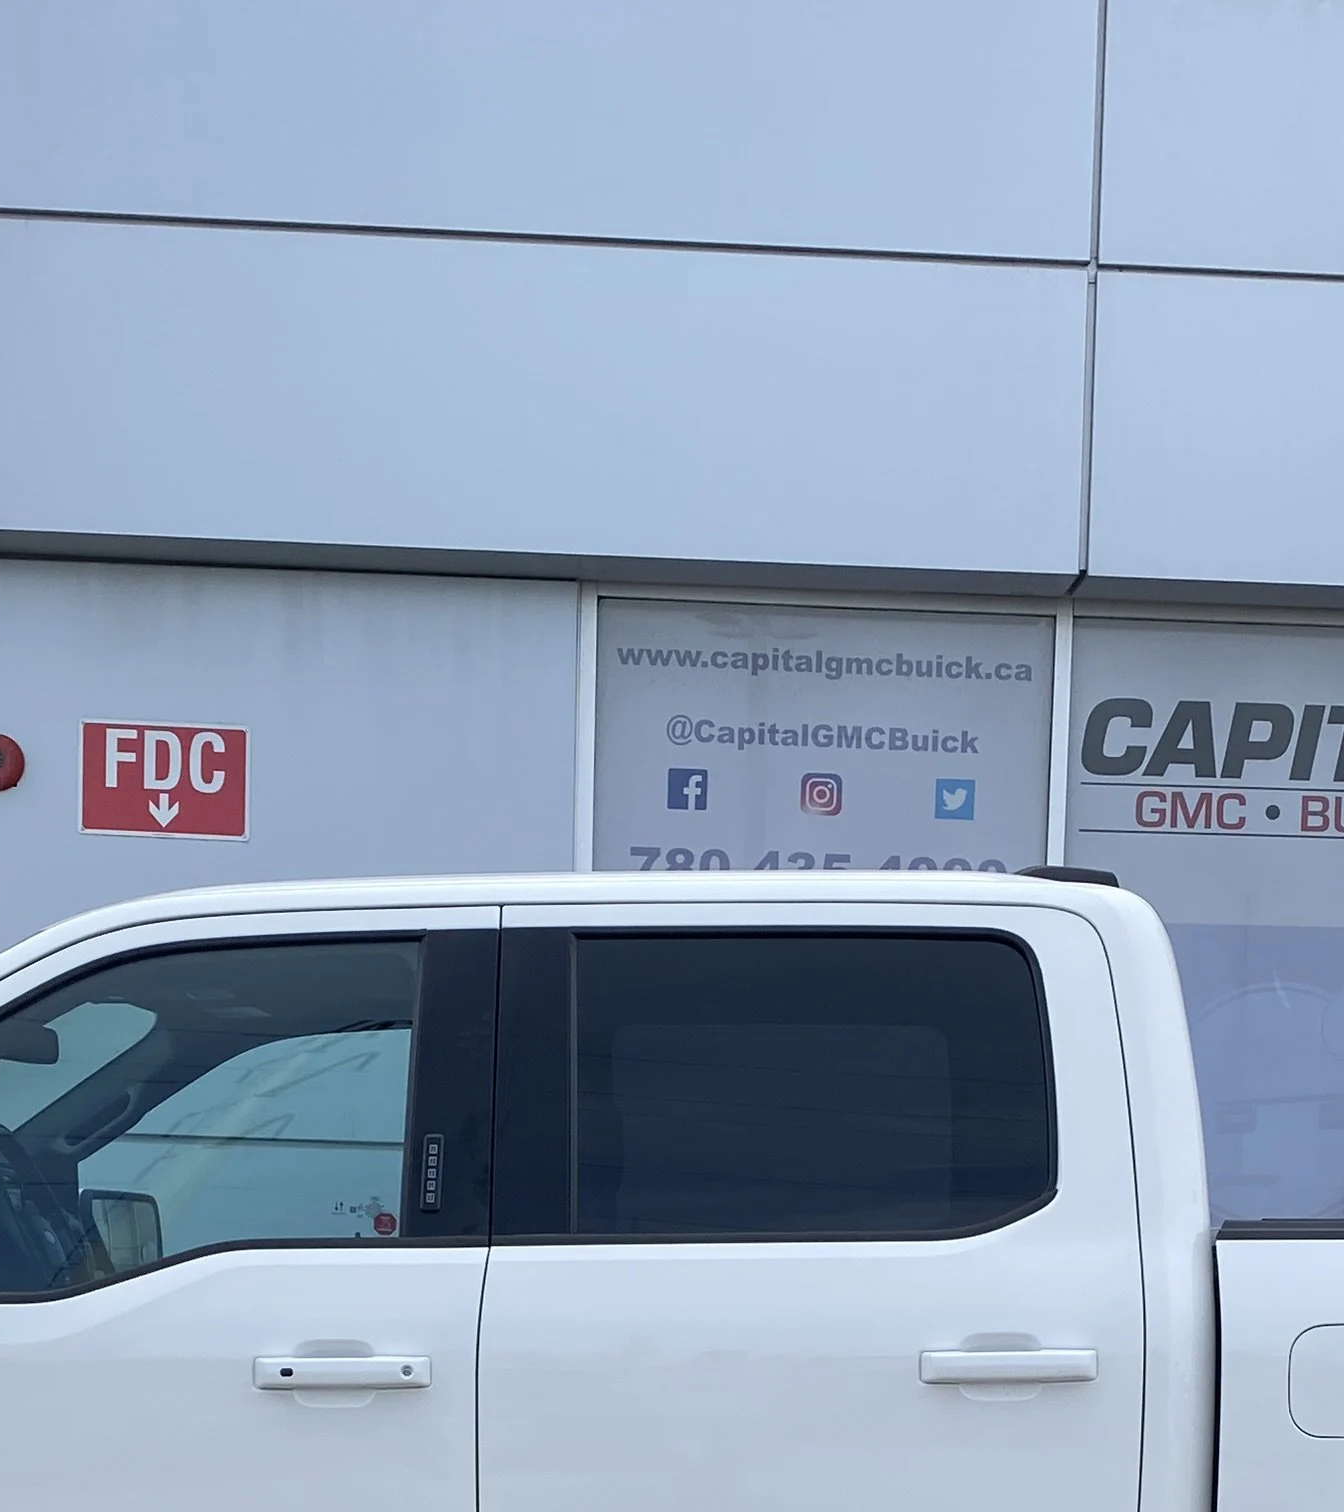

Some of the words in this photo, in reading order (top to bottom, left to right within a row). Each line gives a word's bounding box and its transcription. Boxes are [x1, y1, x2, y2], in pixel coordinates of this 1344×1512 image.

[617, 647, 1033, 681] www.capitalgmcbuick.ca
[666, 714, 980, 754] @CapitalGMCBuick
[105, 728, 226, 794] FDC
[1135, 791, 1247, 831] GMC
